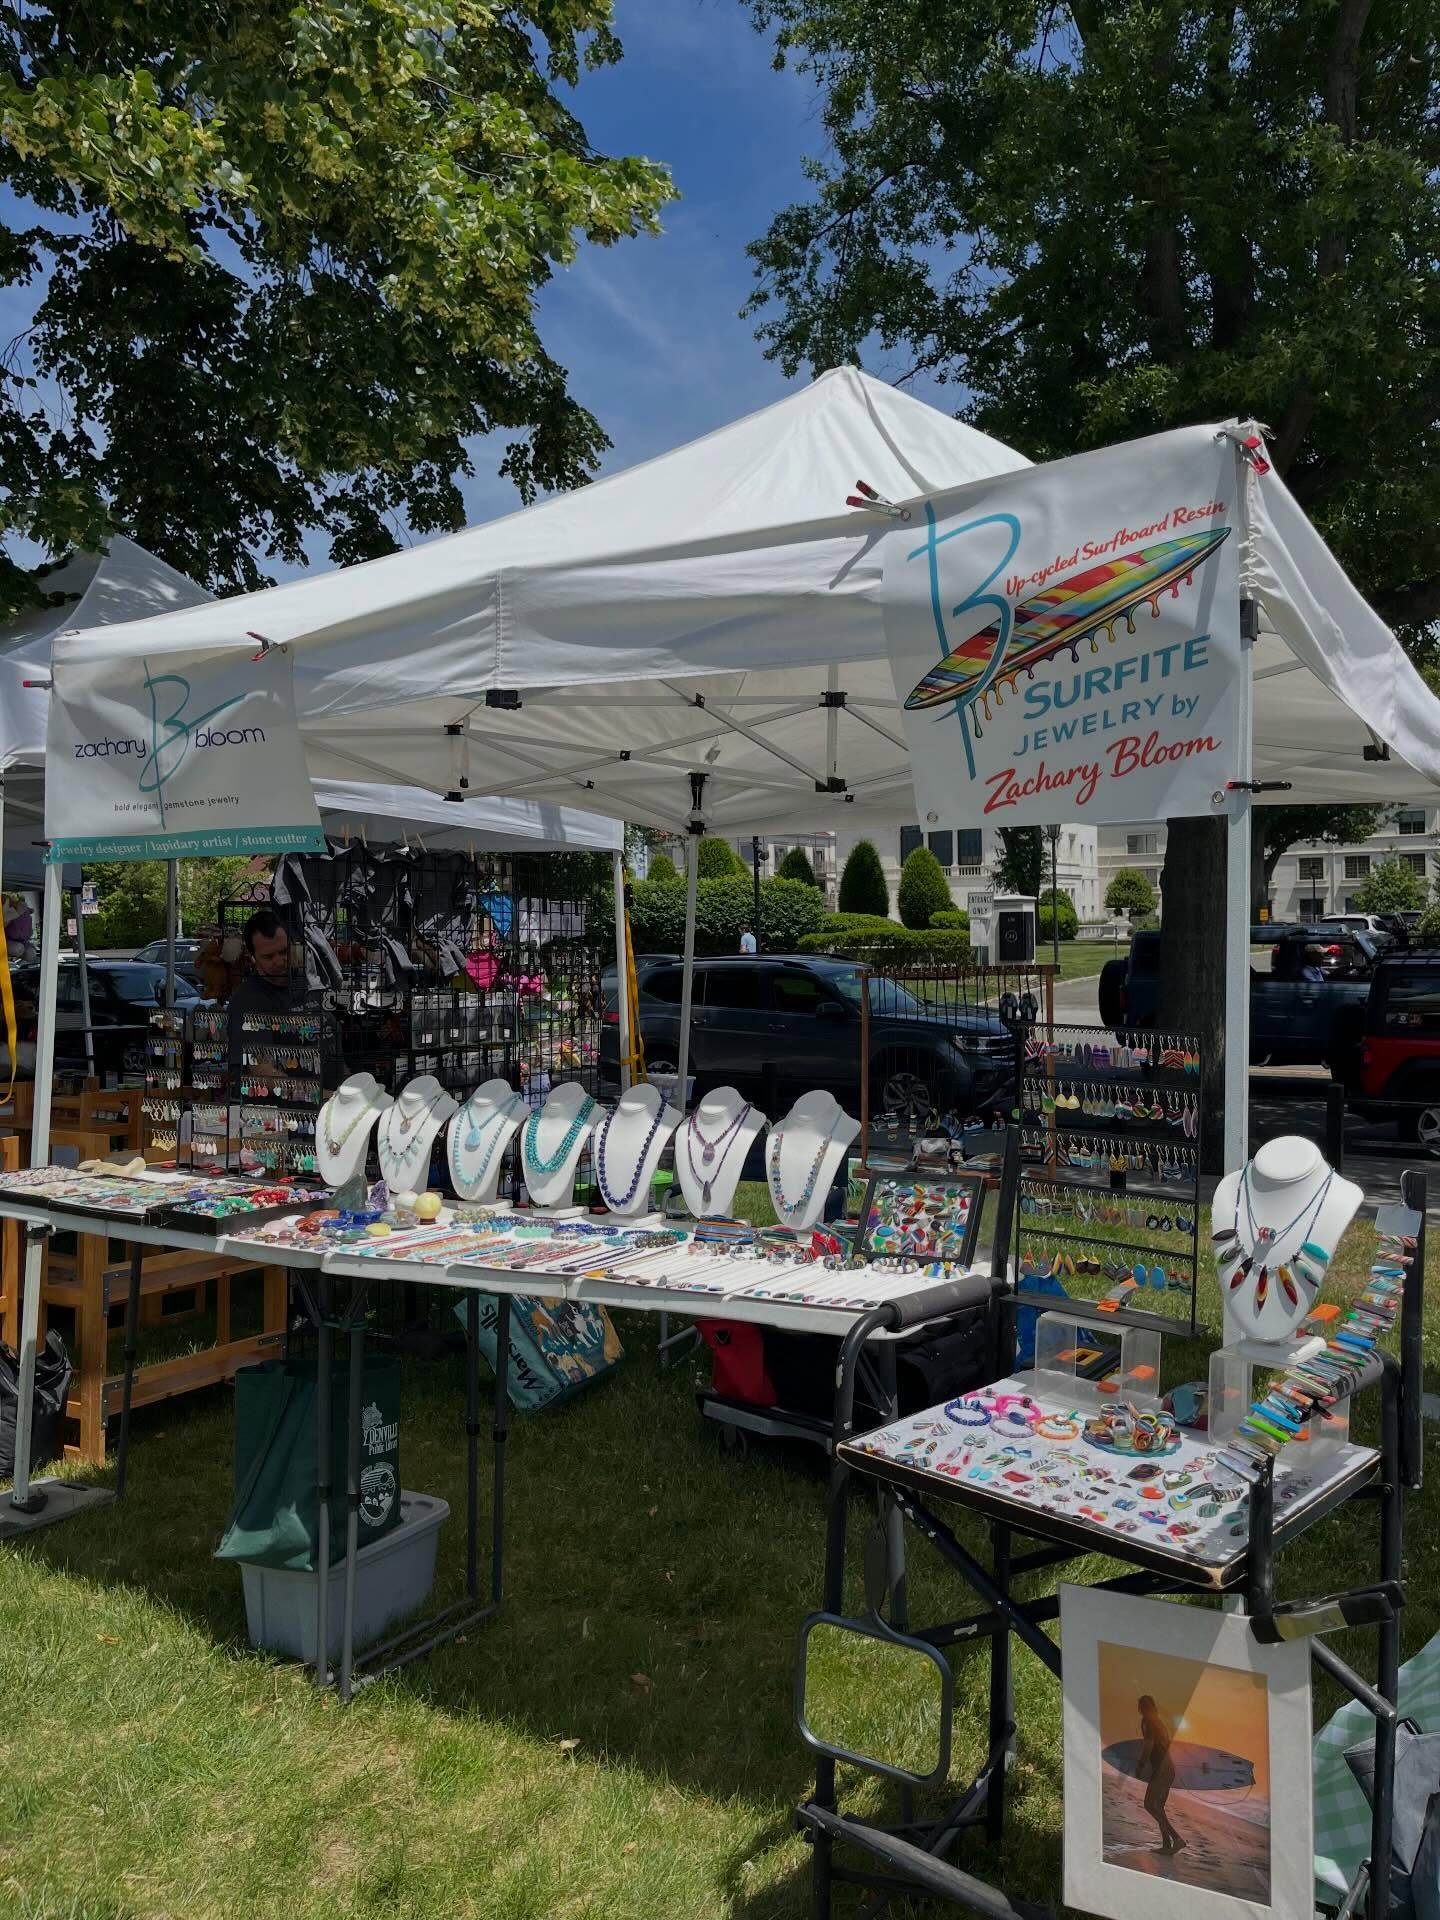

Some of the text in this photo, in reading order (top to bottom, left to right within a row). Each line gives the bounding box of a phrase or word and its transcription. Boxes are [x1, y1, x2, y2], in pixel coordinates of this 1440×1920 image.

[1006, 500, 1226, 598] Up-cycled Surfboard Resin
[1023, 634, 1211, 719] SURFITE
[1013, 694, 1200, 756] JEWELRY by
[75, 726, 266, 759] zachary bloom
[984, 730, 1222, 815] Zachary Bloom
[114, 803, 130, 812] bold
[164, 799, 205, 811] gemstone
[207, 795, 240, 807] jewelry
[57, 833, 308, 858] jewelry designer lapidary artist stone cutter
[968, 895, 993, 904] ENTRANCE
[972, 907, 988, 915] ONLY
